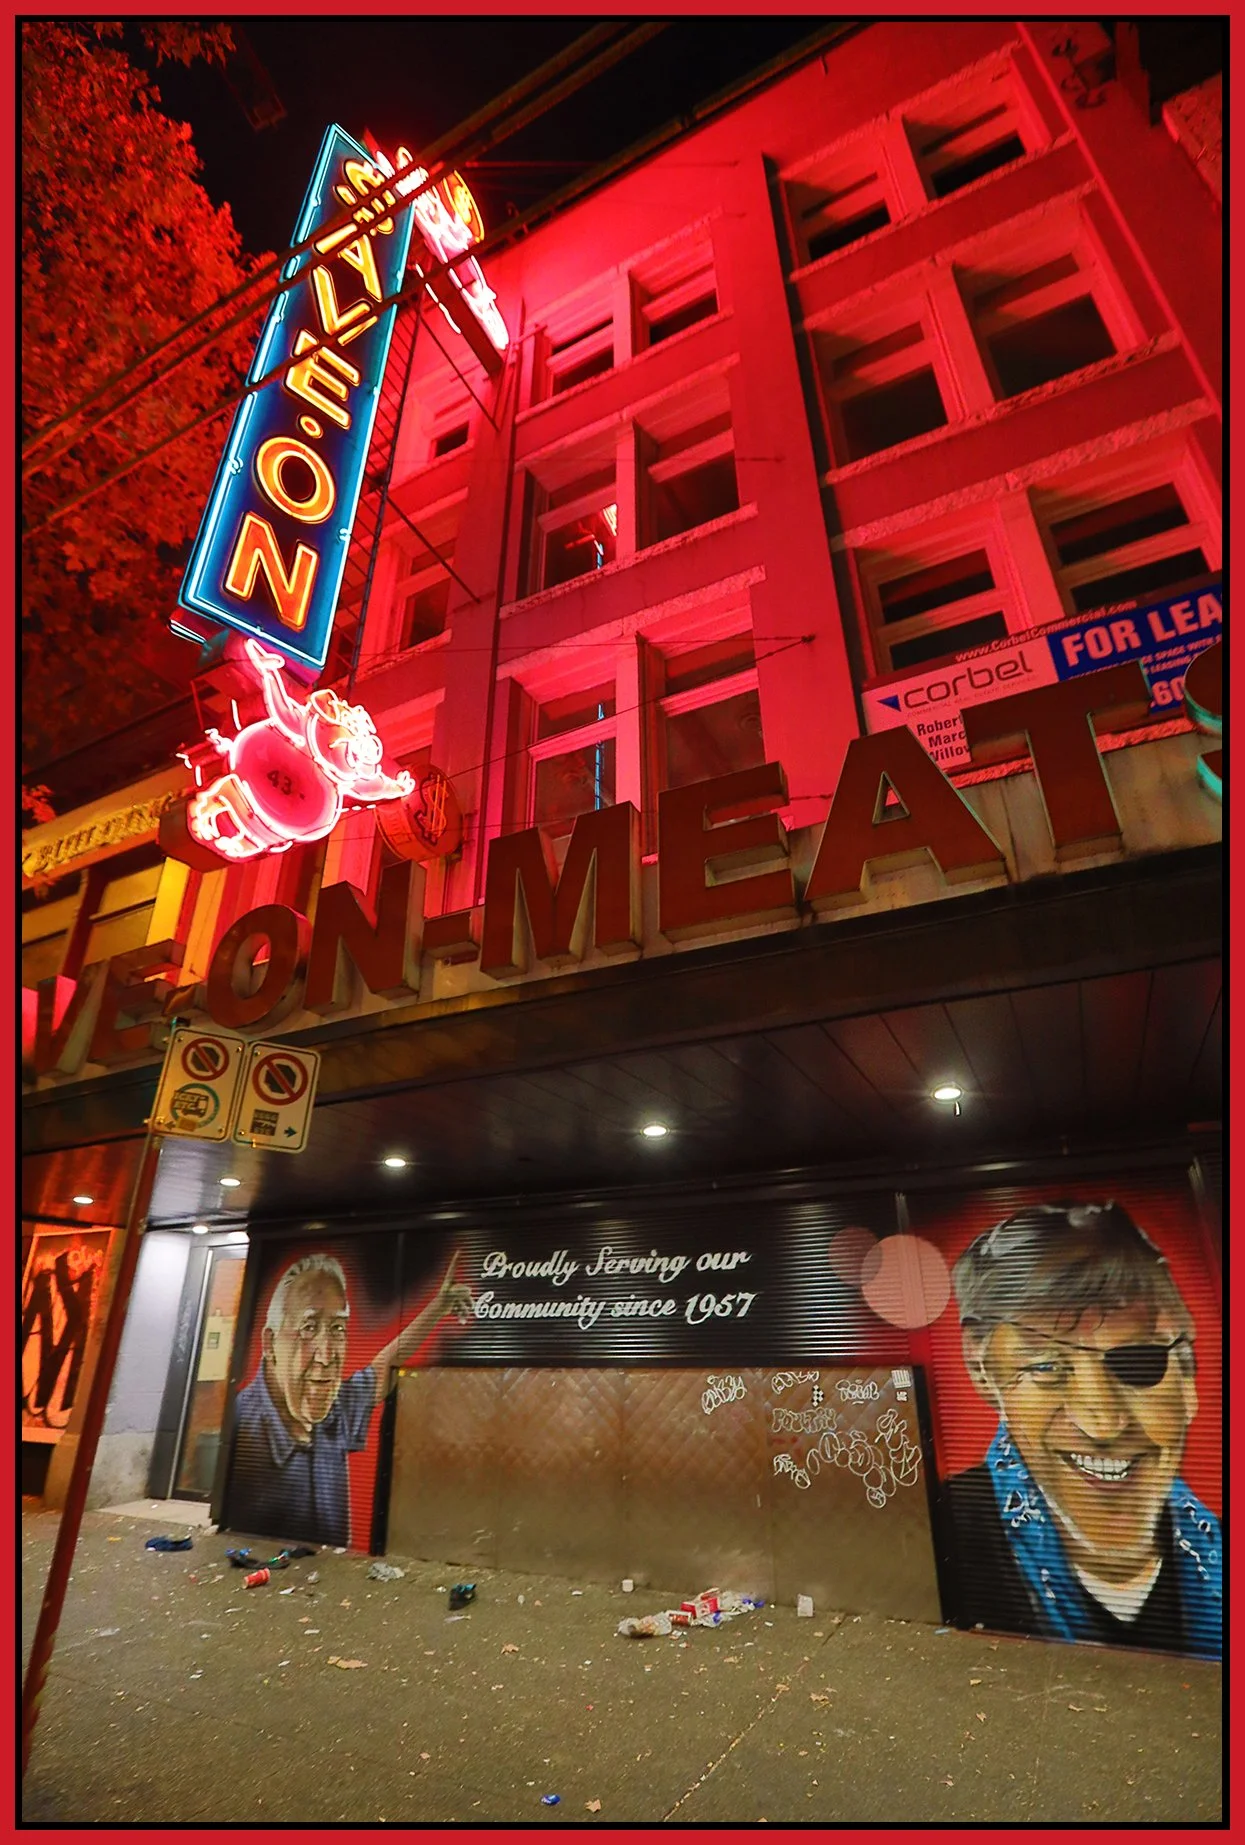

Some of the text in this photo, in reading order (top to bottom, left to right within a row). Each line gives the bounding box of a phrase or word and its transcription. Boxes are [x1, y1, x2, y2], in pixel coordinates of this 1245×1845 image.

[954, 600, 1138, 662] www.CorbelCommercial.com
[1061, 592, 1222, 668] FOR LEA
[903, 650, 1034, 709] corbel
[481, 1246, 753, 1286] Proudly Serving our
[474, 1291, 758, 1330] Community since 1957
